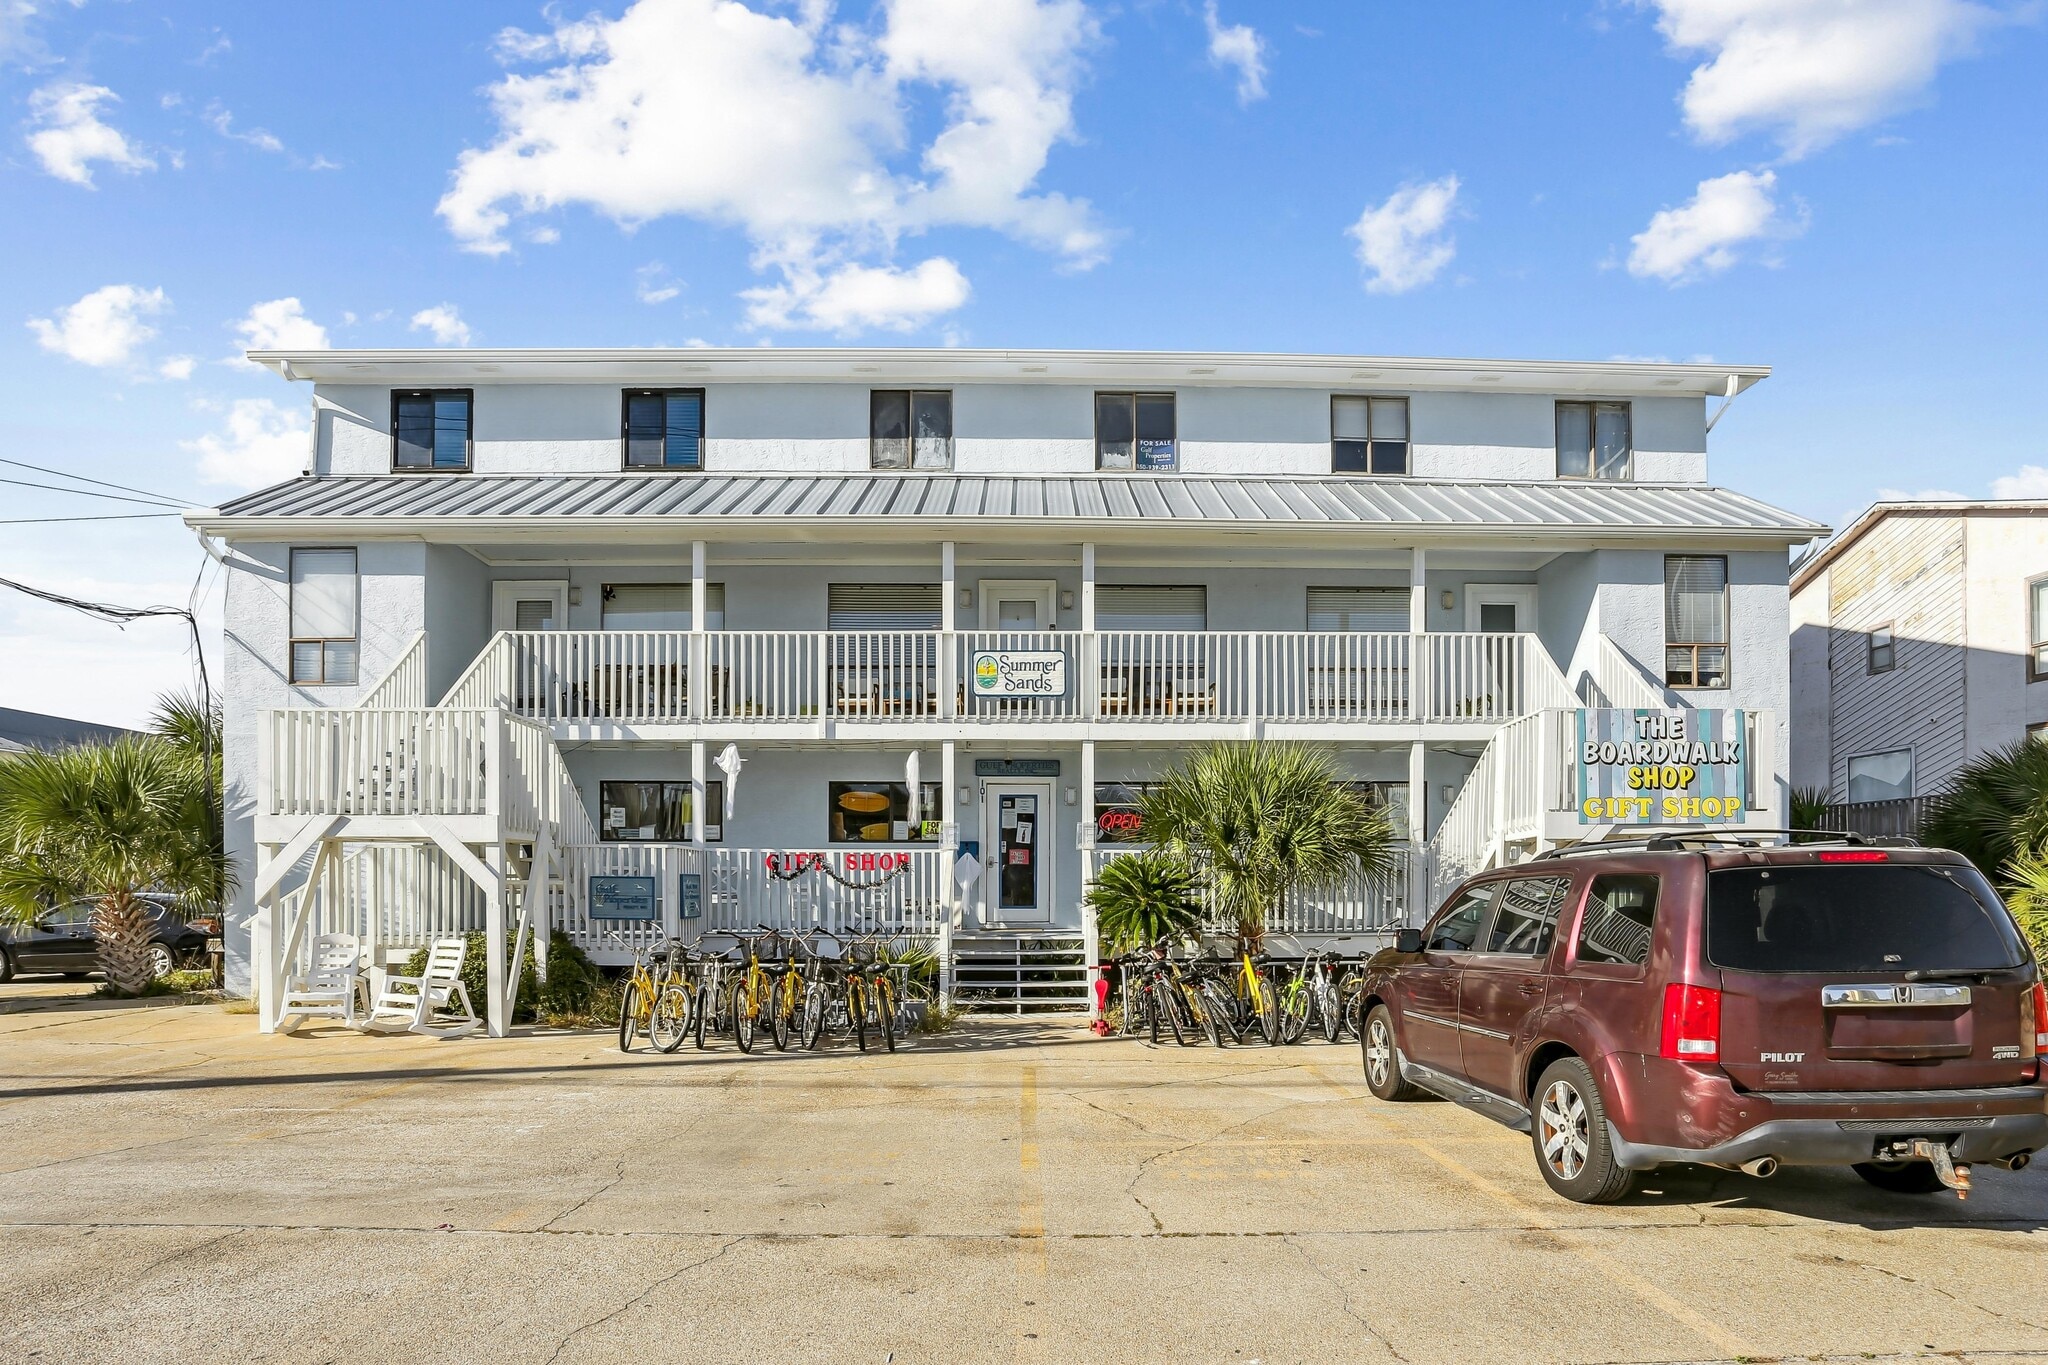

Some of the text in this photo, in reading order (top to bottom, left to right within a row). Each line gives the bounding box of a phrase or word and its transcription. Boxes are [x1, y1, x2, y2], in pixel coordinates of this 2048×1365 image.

[1000, 655, 1063, 674] Summer
[1004, 672, 1052, 692] Sands
[1636, 716, 1684, 740] THE
[1583, 741, 1740, 765] BOARDWALK
[979, 761, 1003, 769] GULF
[1628, 766, 1695, 790] SHOP
[1582, 797, 1741, 818] GIFT SHOP
[1101, 813, 1143, 829] OPEN
[765, 853, 825, 871] GIFT
[845, 853, 910, 871] SHOP
[1760, 1052, 1806, 1063] PILOT
[1992, 1051, 2020, 1060] 4WD
